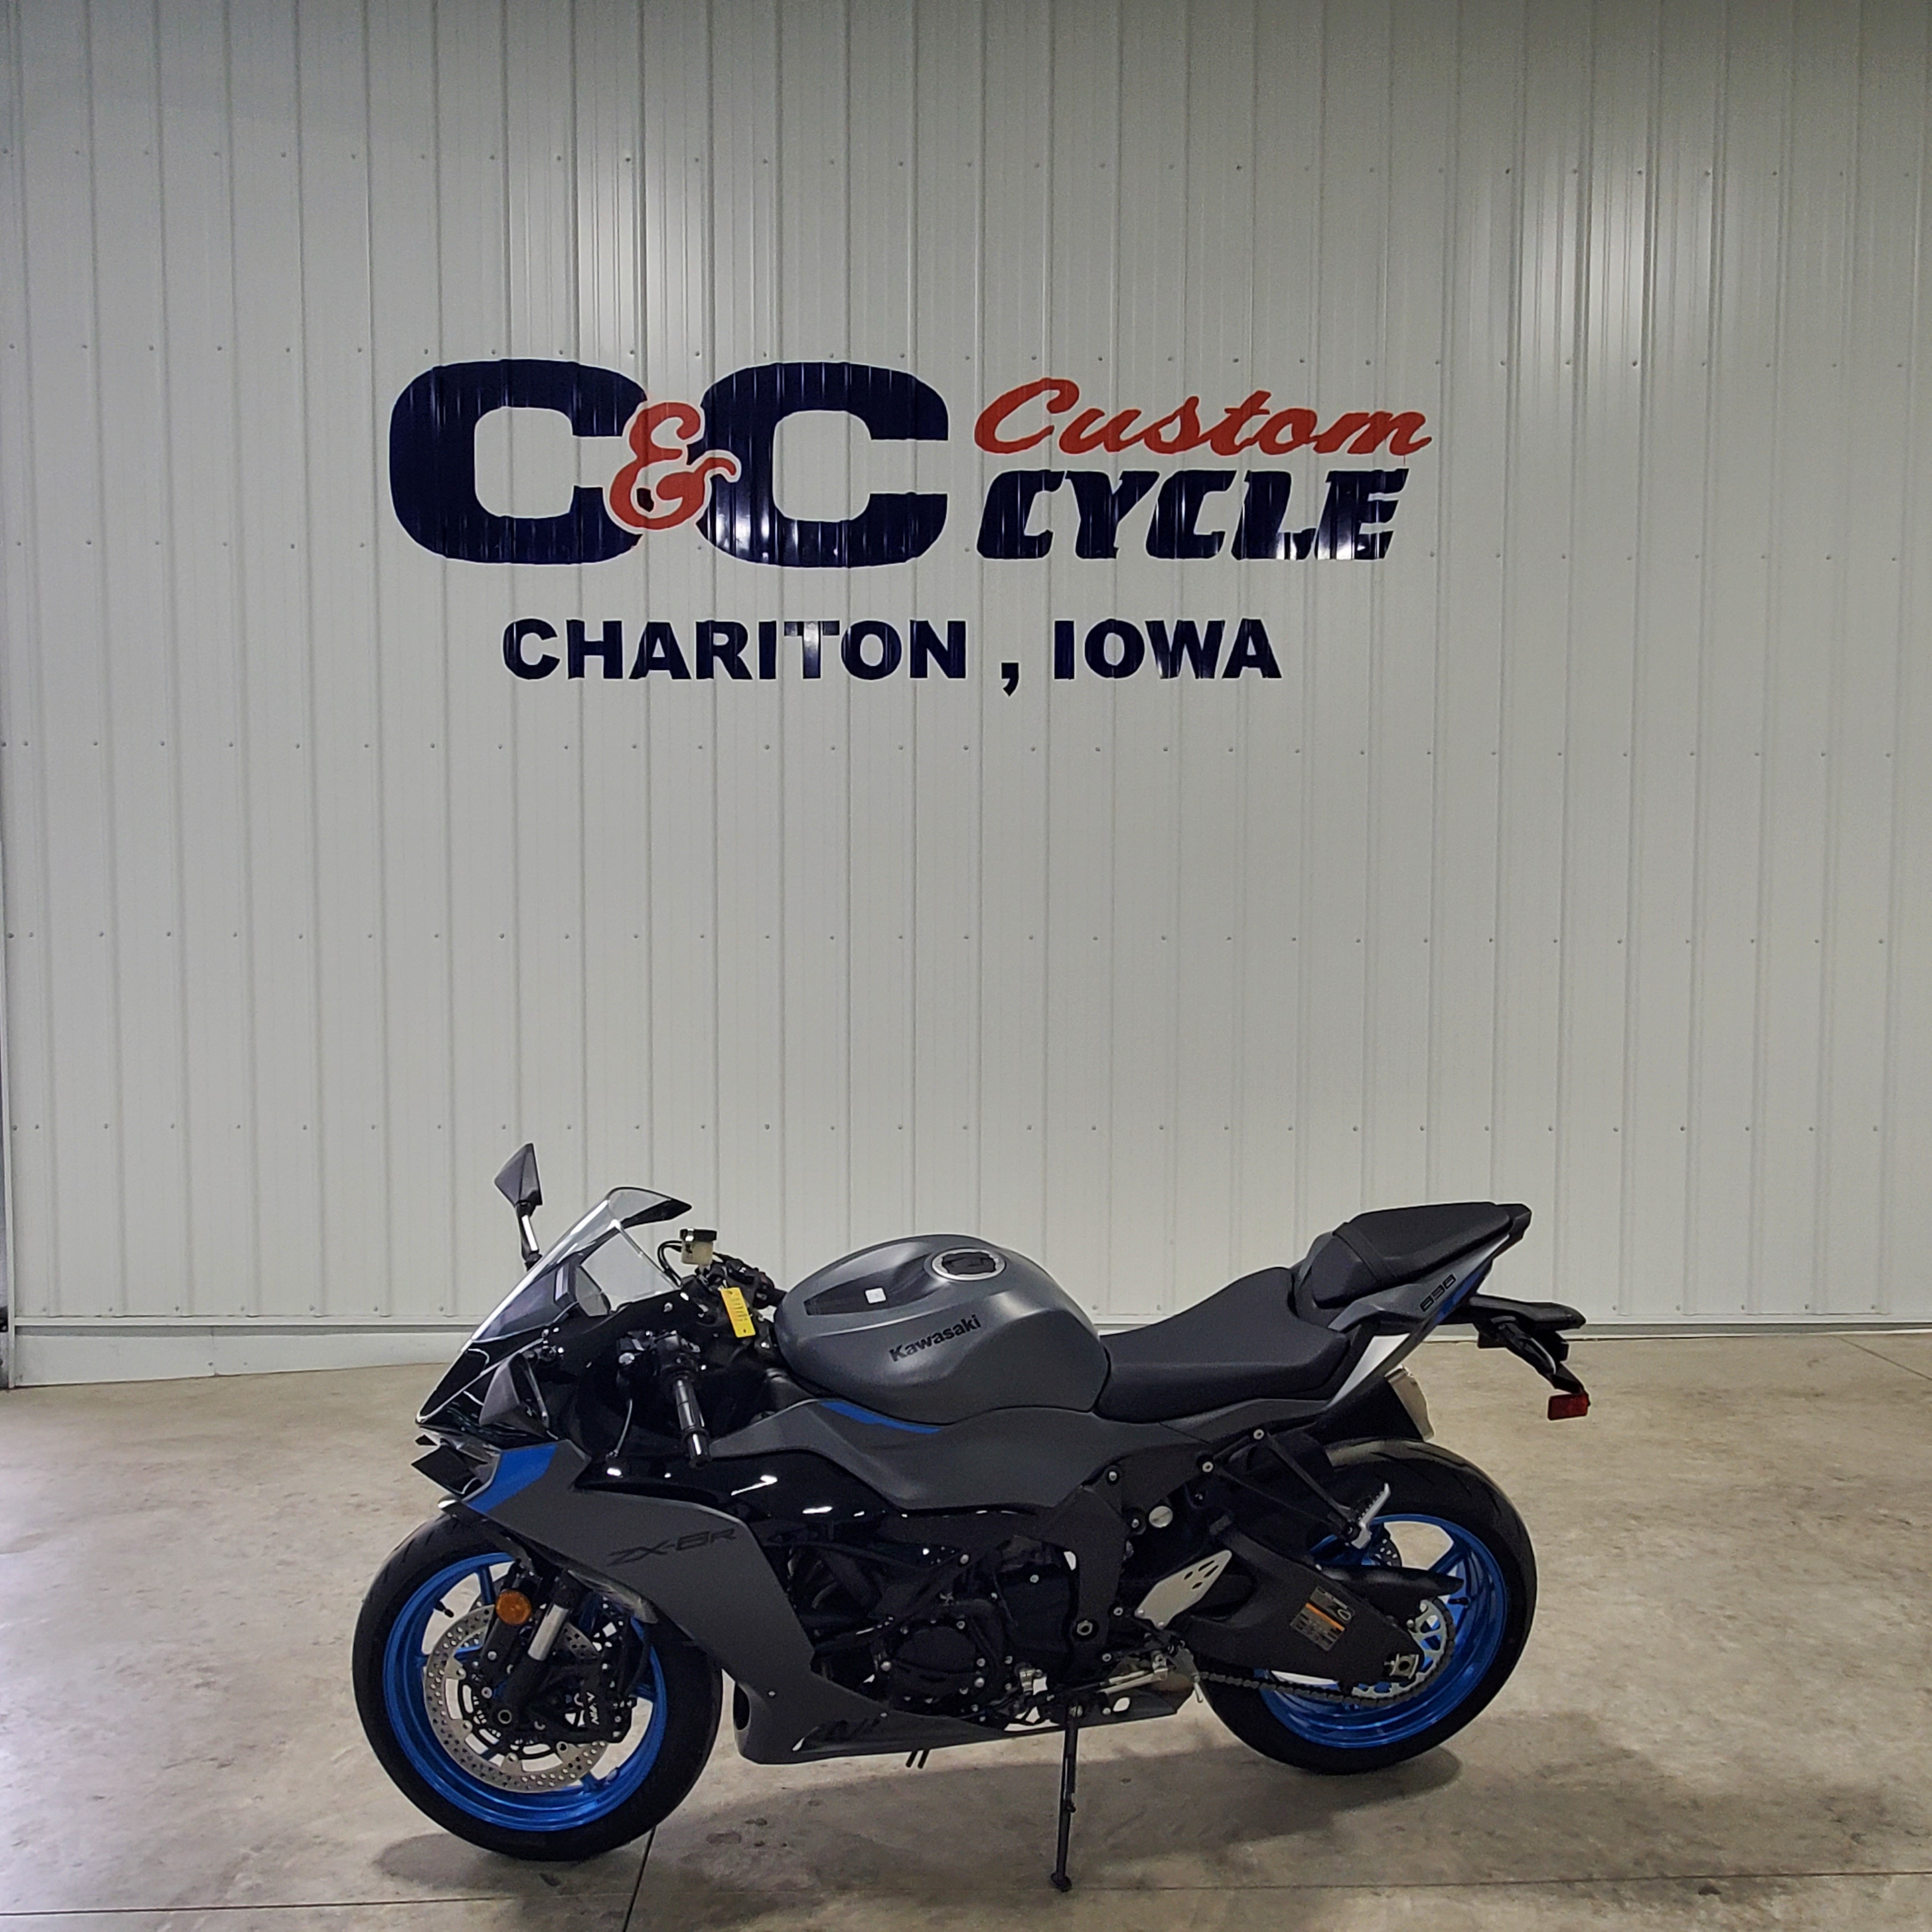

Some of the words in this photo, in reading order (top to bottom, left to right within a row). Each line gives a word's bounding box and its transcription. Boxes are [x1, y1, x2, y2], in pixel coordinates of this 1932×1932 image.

[974, 377, 1432, 456] Custom
[390, 359, 949, 569] C&C
[977, 468, 1409, 561] CYCLE
[503, 618, 966, 680] CHARITON
[1054, 618, 1282, 680] IOWA
[889, 1314, 981, 1362] Kawasaki
